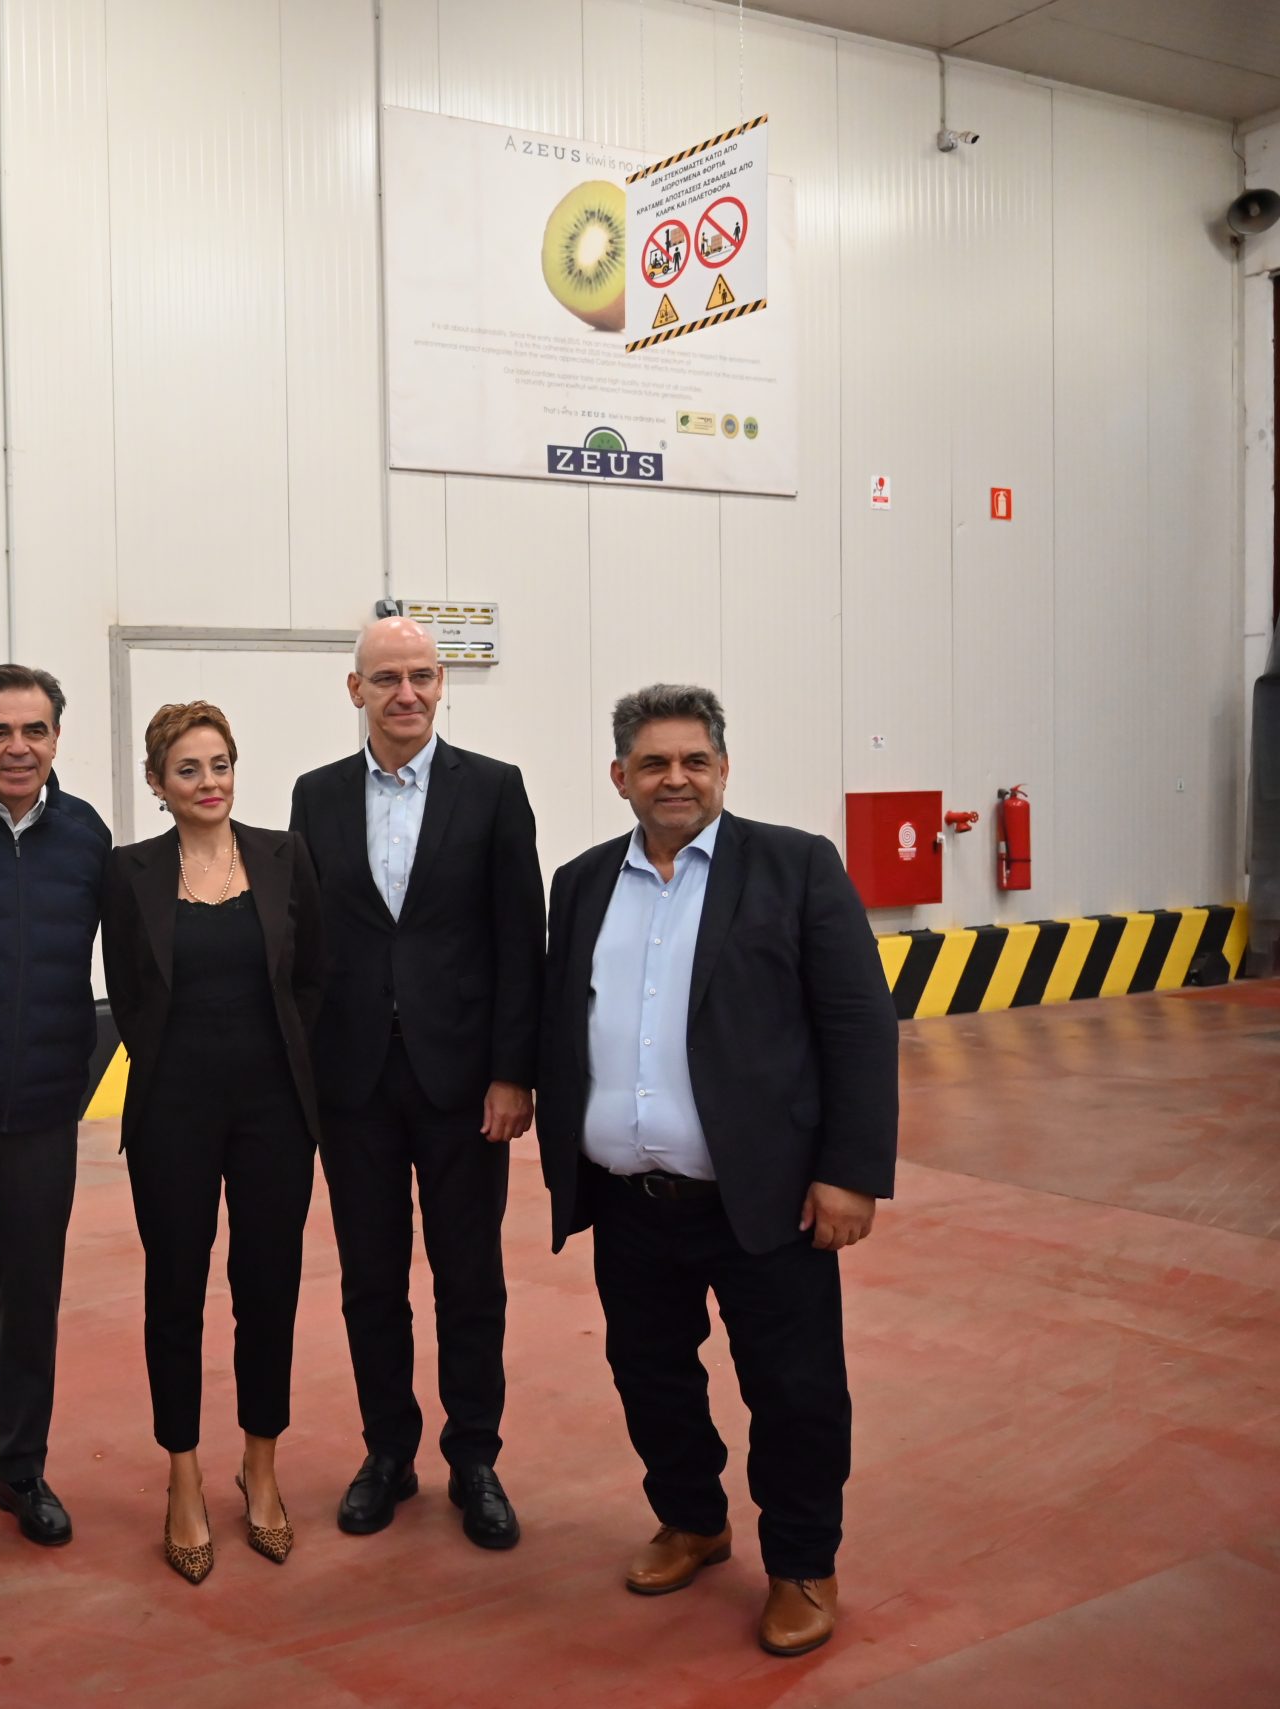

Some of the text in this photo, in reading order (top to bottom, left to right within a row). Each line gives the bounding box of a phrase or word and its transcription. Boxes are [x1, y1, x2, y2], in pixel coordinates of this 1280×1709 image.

[504, 135, 517, 152] A
[522, 140, 581, 163] ZEUS
[585, 153, 606, 168] kiwi
[608, 158, 616, 169] is
[619, 160, 633, 172] no
[650, 143, 738, 187] ΔΕΝ ΣΤΕΚΟΜΑΣΤΕ ΚΑΤΩ ΑΠΟ
[636, 161, 754, 216] ΚΡΑΤΑΜΕ ΑΠΟΣΤΑΣΕΙΣ ΑΣΦΑΛΕΙΑΣ ΑΠΟ
[661, 160, 726, 193] ΑΙΩΡΟΥΜΕΝΑ ΦΟΡΤΙΑ
[655, 182, 731, 218] ΚΛΑΡΚ ΚΑΙ ΠΑΛΕΤΟΦΟΡΑ
[581, 409, 606, 418] ZEUS
[556, 448, 656, 478] ZEUS
